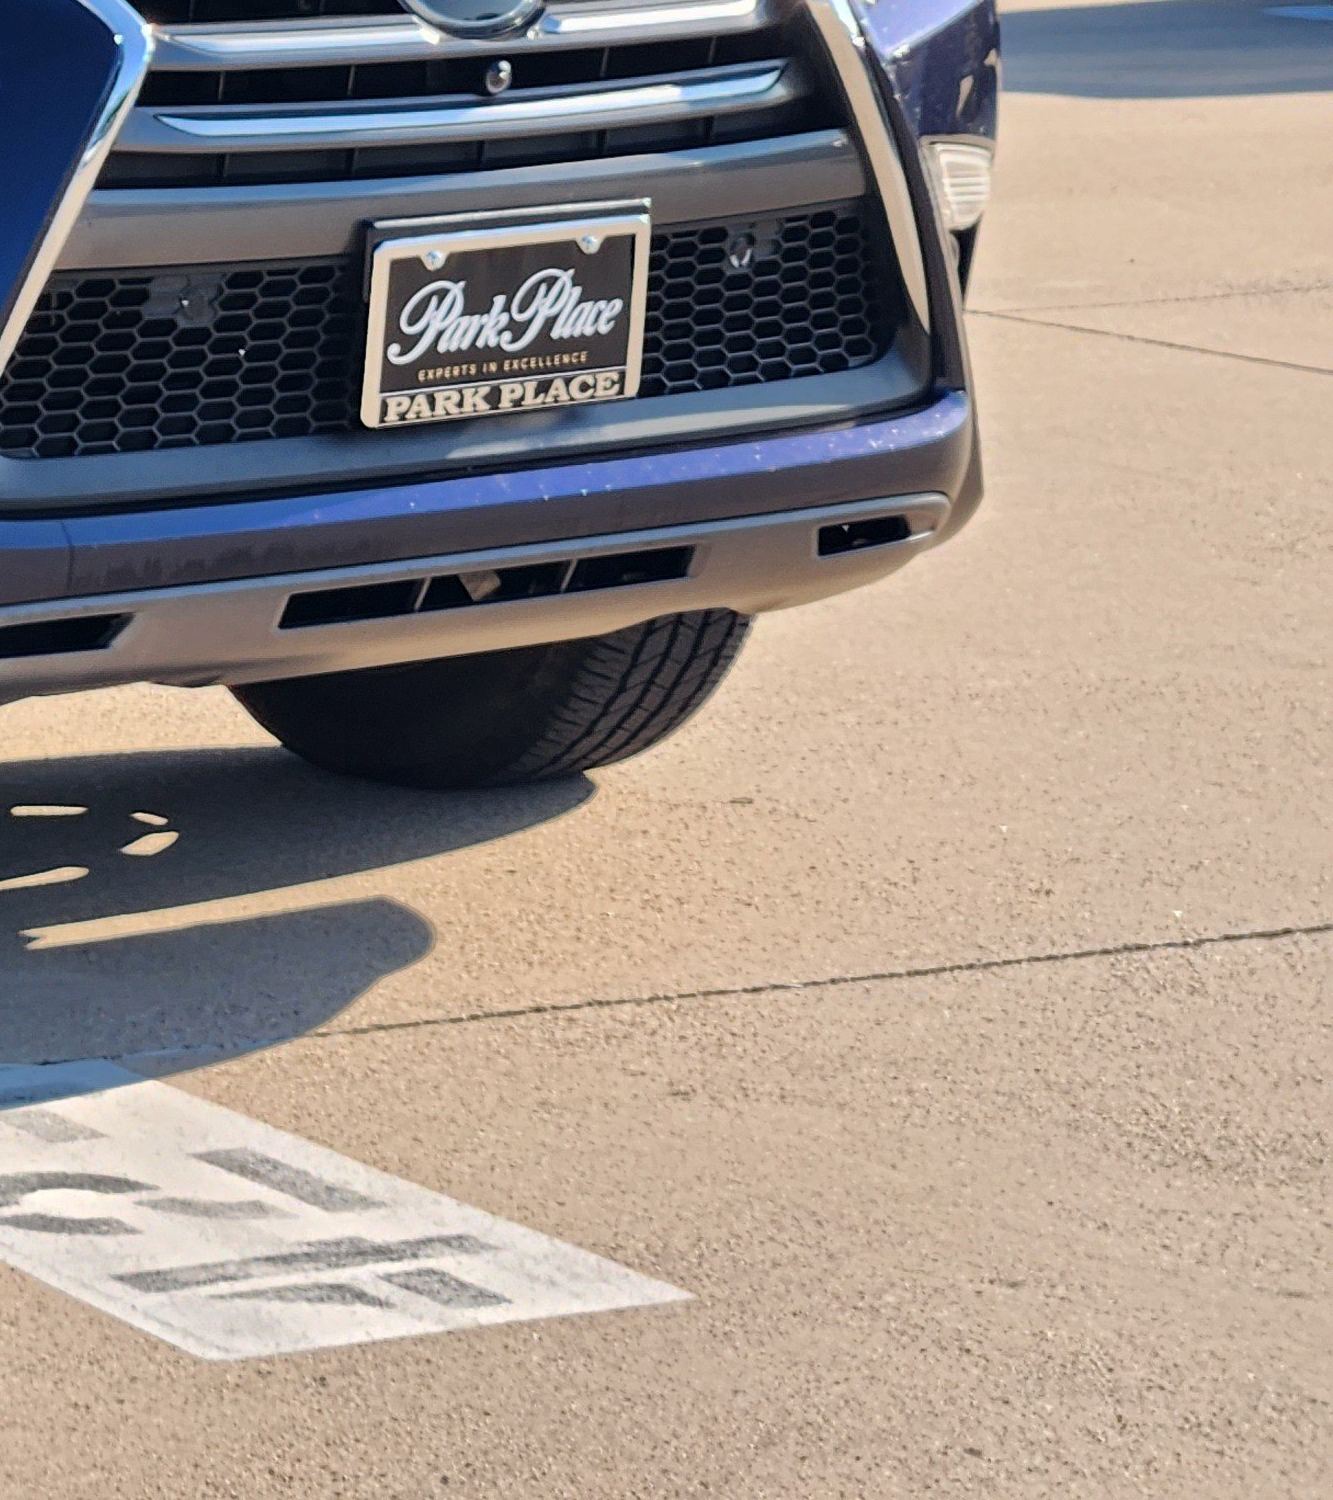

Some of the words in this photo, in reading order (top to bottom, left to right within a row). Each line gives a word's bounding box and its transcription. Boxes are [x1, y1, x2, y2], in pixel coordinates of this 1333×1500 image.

[386, 280, 510, 365] Park
[499, 267, 624, 353] Place
[417, 362, 478, 383] EXPERTS
[482, 359, 498, 374] IN
[503, 350, 589, 372] EXCELLENCE
[383, 383, 492, 423] PARK
[498, 371, 621, 410] PLACE
